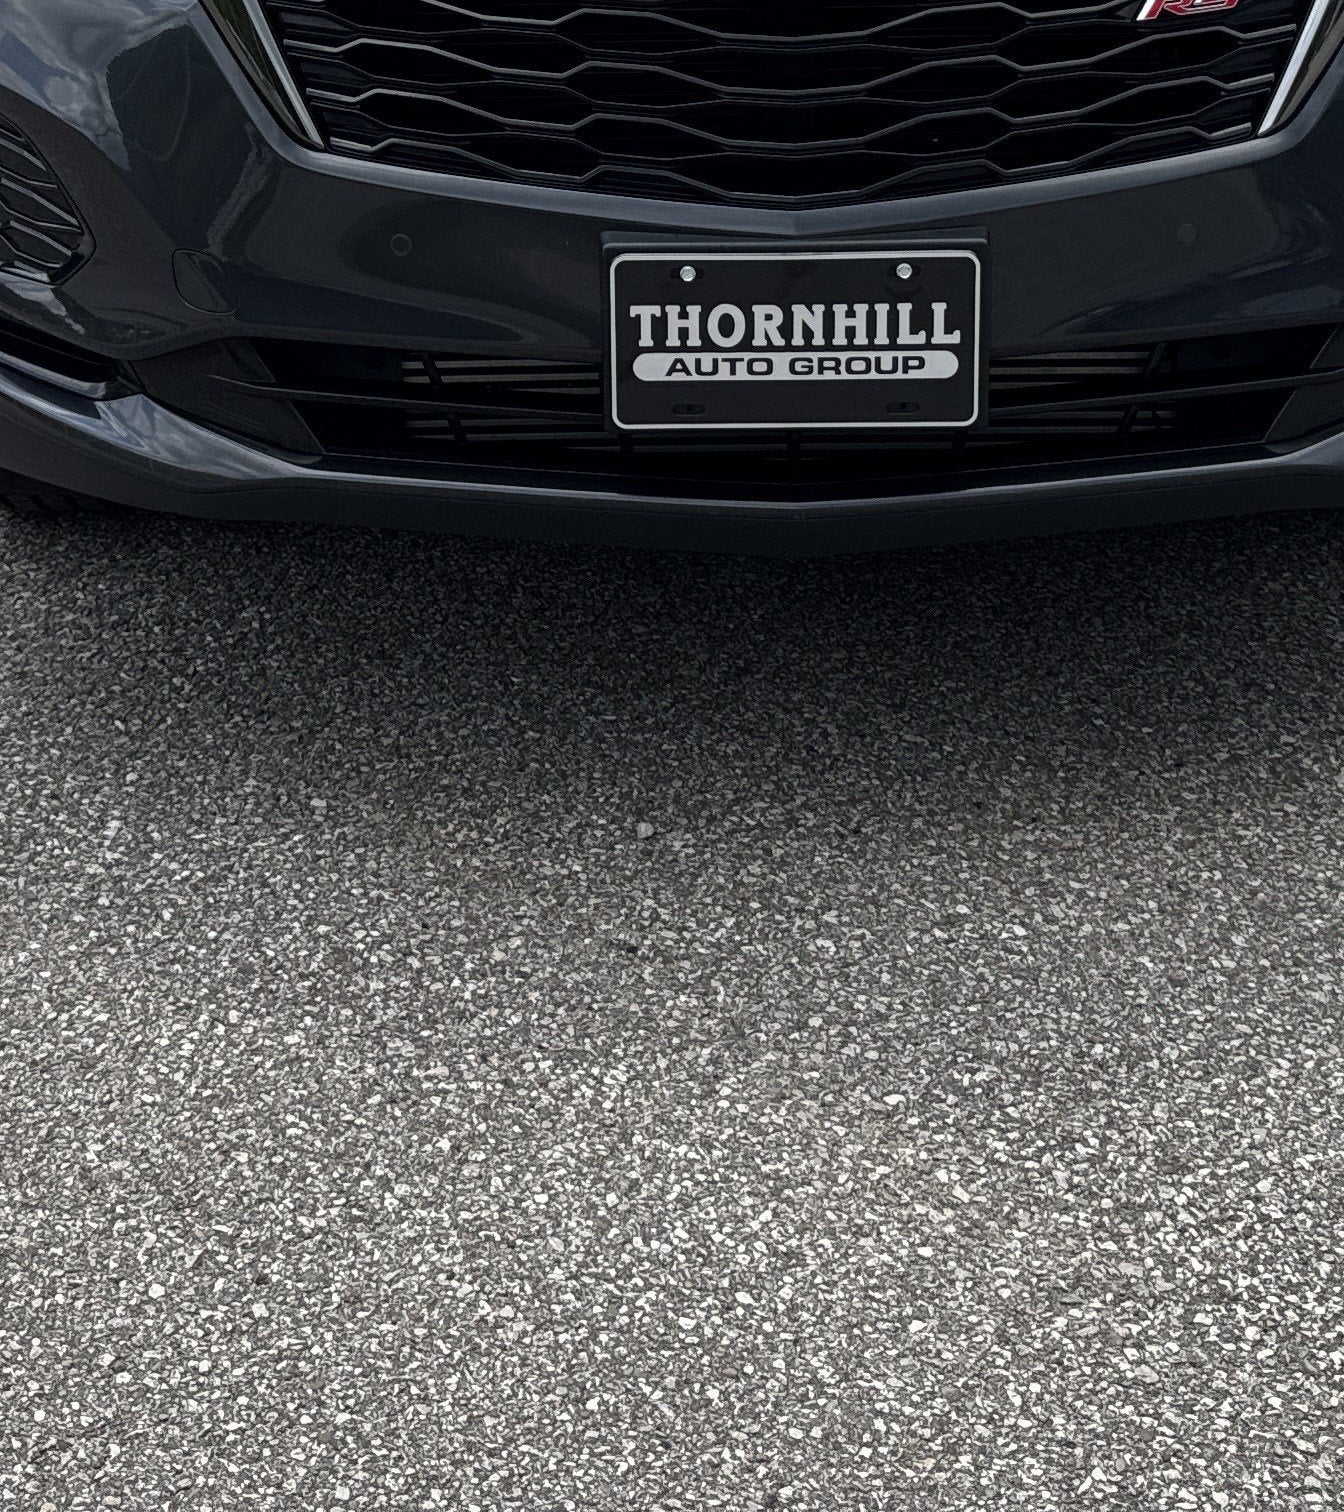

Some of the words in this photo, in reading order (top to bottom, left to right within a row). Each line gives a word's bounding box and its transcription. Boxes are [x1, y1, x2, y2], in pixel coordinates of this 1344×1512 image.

[629, 303, 961, 347] THORNHILL
[665, 356, 774, 377] AUTO
[788, 354, 926, 376] GROUP
